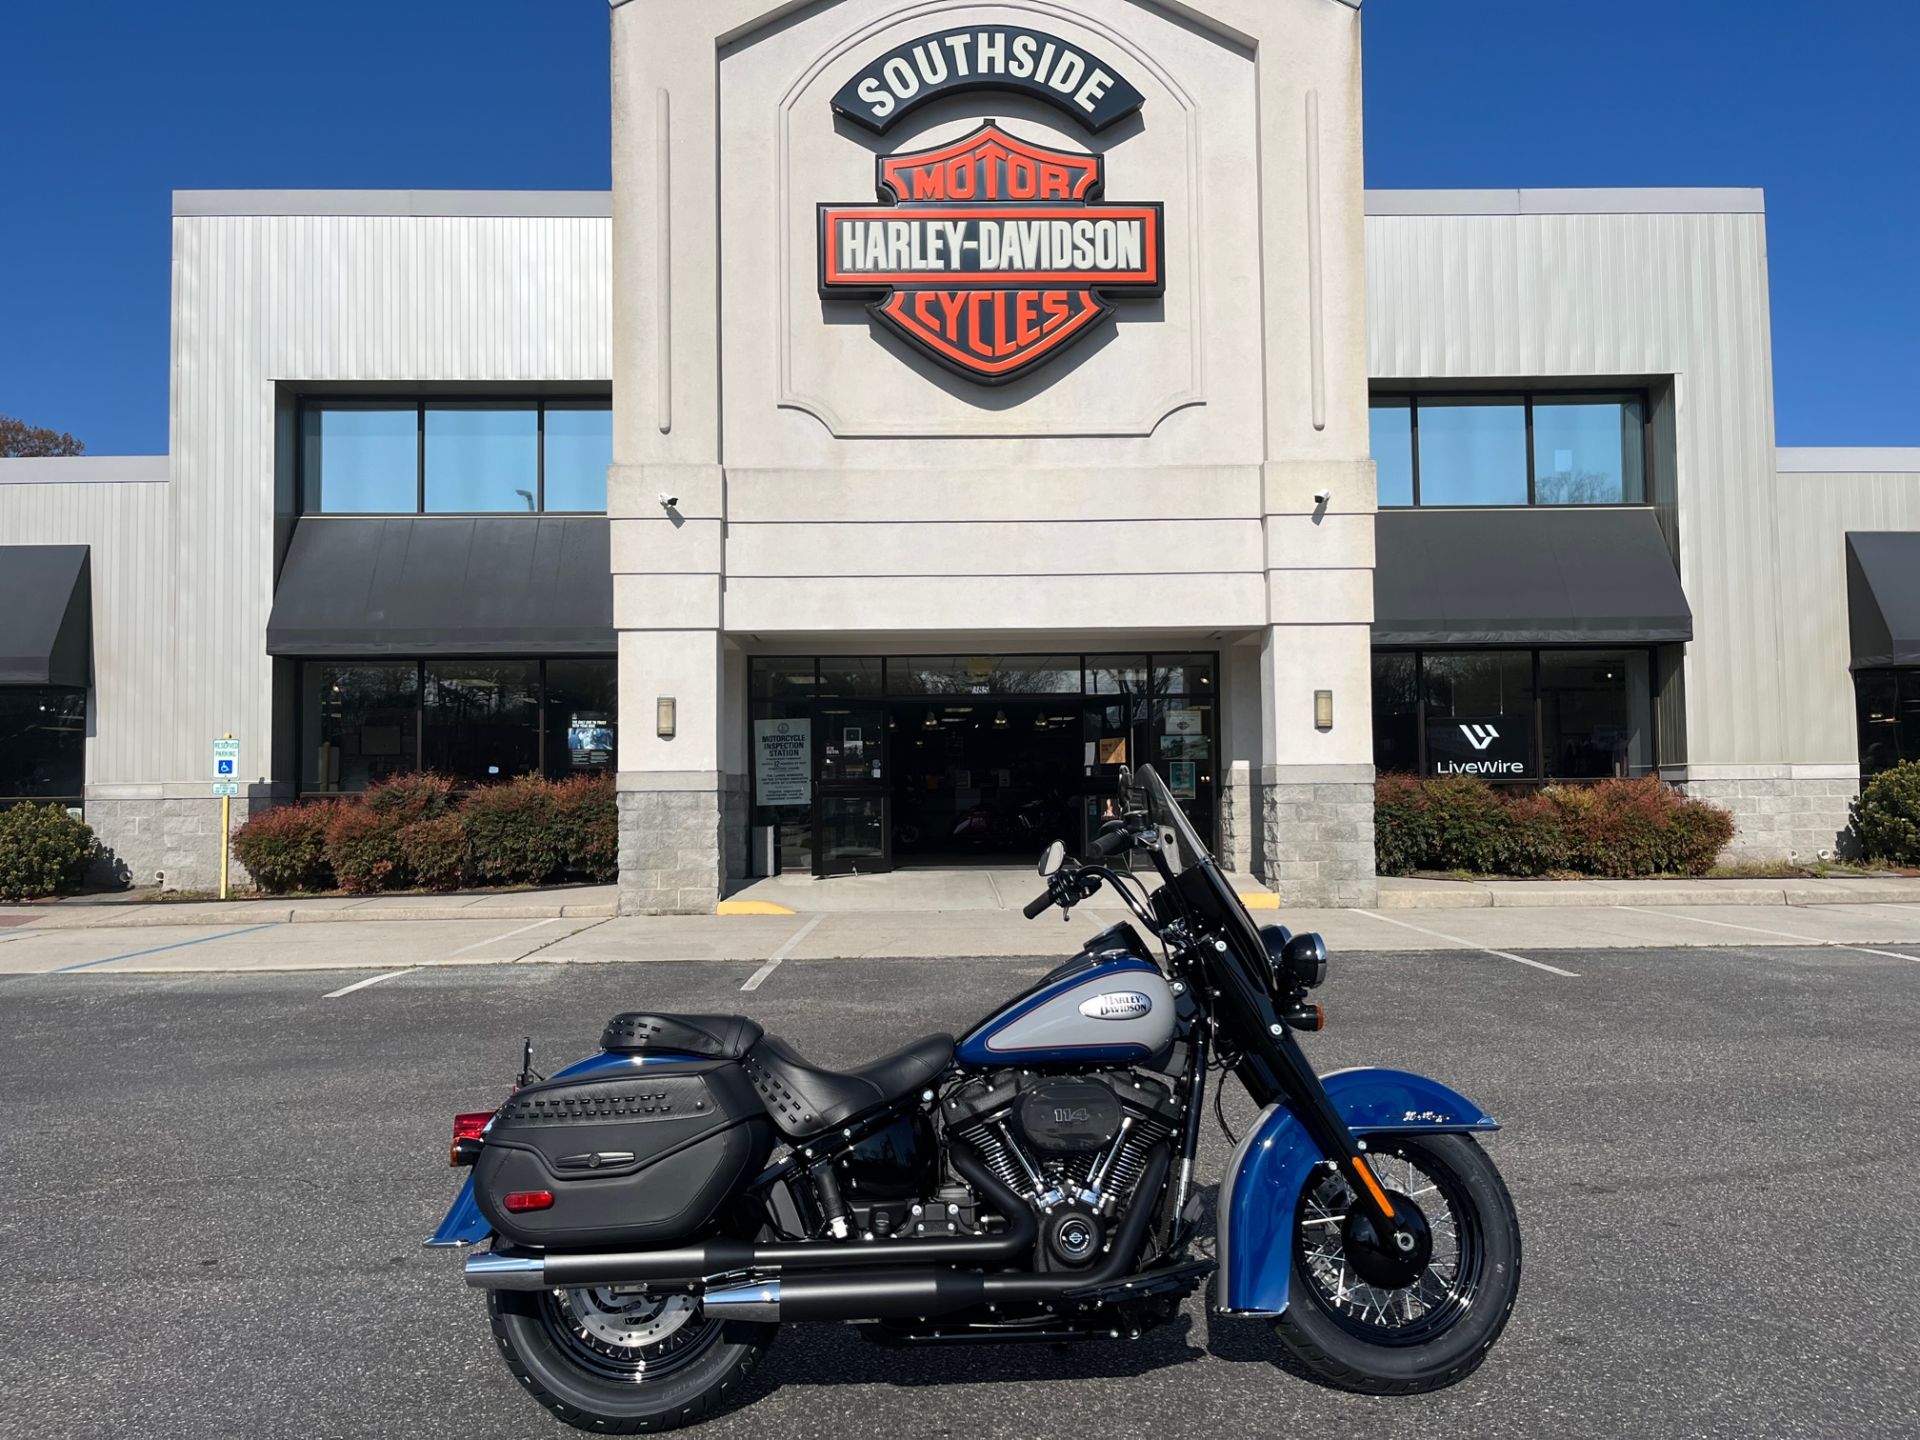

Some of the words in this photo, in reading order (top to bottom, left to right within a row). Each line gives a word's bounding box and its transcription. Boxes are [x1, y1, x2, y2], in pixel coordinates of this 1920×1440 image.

[857, 32, 1115, 117] SOUTHSIDE
[912, 142, 1070, 200] MOTOR
[841, 219, 1142, 271] HARLEY-DAVIDSON
[914, 291, 1071, 357] CYCLES
[761, 734, 806, 743] MOTORCYCLE
[763, 742, 805, 750] INSPECTION
[768, 749, 799, 757] STATION
[1437, 759, 1524, 774] LiveWire
[1100, 1003, 1147, 1016] DAVIDSON
[1054, 1107, 1091, 1122] 114
